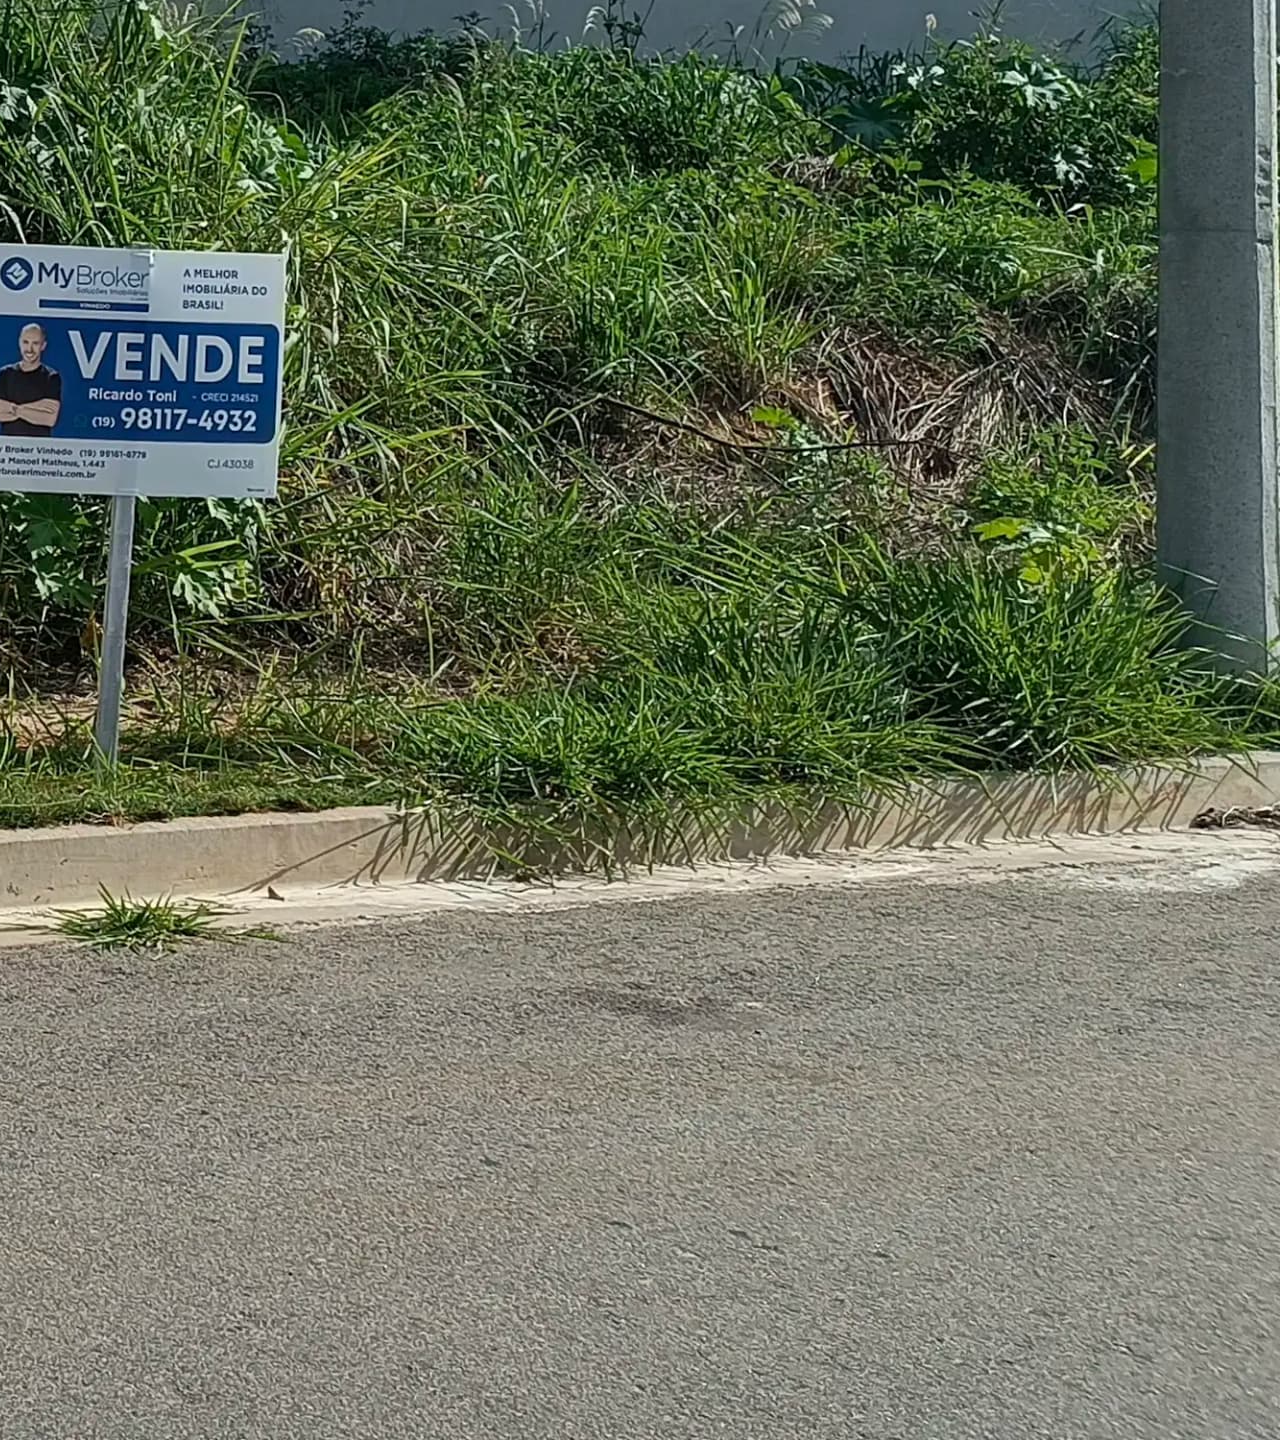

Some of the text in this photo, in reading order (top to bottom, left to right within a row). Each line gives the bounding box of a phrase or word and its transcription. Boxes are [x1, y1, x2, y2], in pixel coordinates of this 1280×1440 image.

[183, 269, 239, 279] A MELHOR
[183, 282, 268, 296] IMOBILIÁRIA DO
[182, 300, 224, 310] BRASIL!
[67, 330, 264, 383] VENDE
[89, 388, 143, 401] Ricardo
[146, 390, 177, 402] Toni
[201, 393, 228, 401] CRECI
[92, 407, 257, 432] (19) 98117-4932
[4, 446, 33, 454] Broker
[36, 447, 73, 456] Vinhedo
[79, 449, 96, 458] (19)
[42, 460, 80, 468] Matheus,
